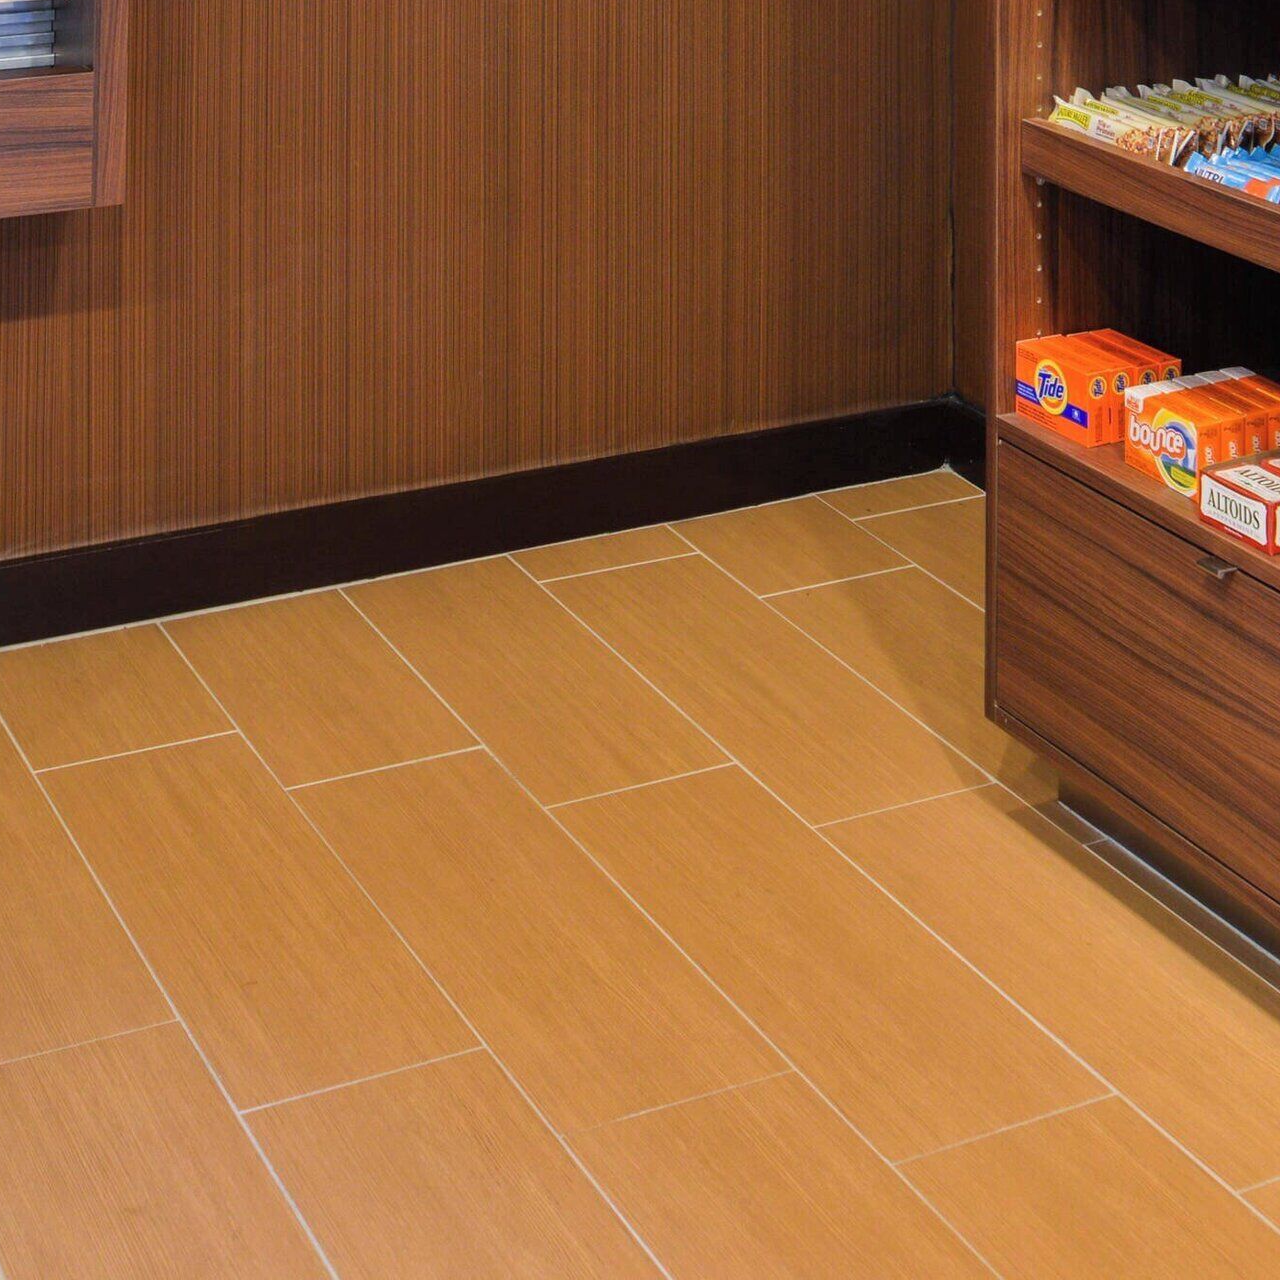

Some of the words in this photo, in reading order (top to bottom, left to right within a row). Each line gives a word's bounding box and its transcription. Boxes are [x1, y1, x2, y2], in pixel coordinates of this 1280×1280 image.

[1038, 372, 1065, 400] Tide
[1092, 376, 1103, 398] Tide
[1129, 412, 1184, 455] bounce
[1208, 487, 1260, 530] ALTOIDS
